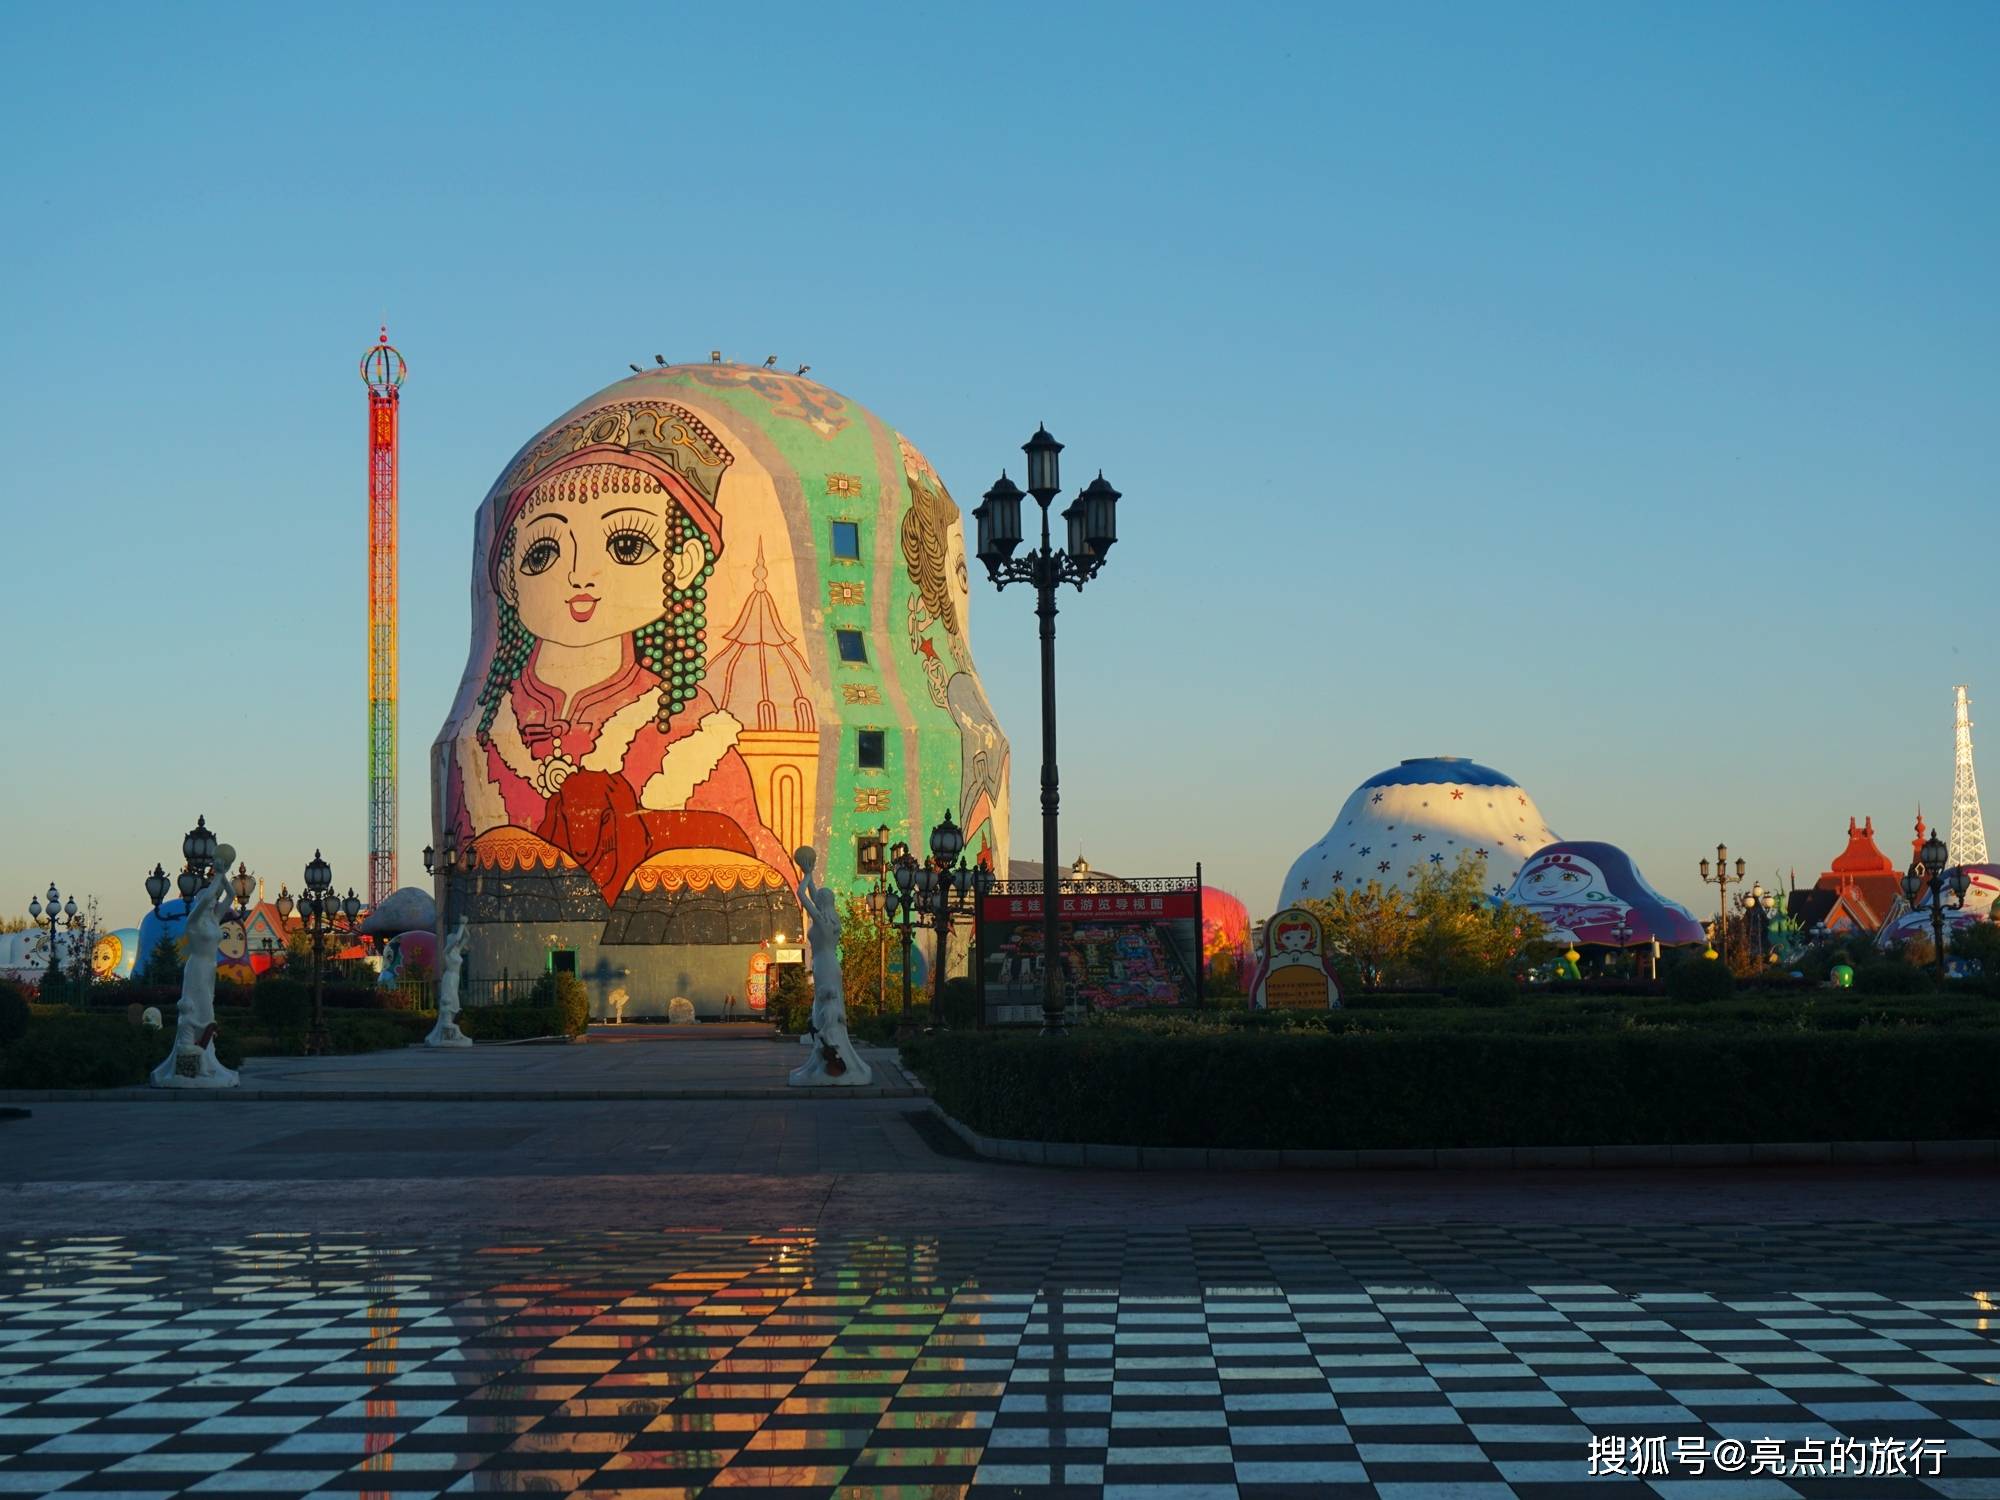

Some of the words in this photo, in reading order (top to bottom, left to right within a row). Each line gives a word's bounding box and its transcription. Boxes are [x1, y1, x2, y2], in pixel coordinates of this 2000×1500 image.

[1010, 898, 1163, 912] 套娃区游览导视图
